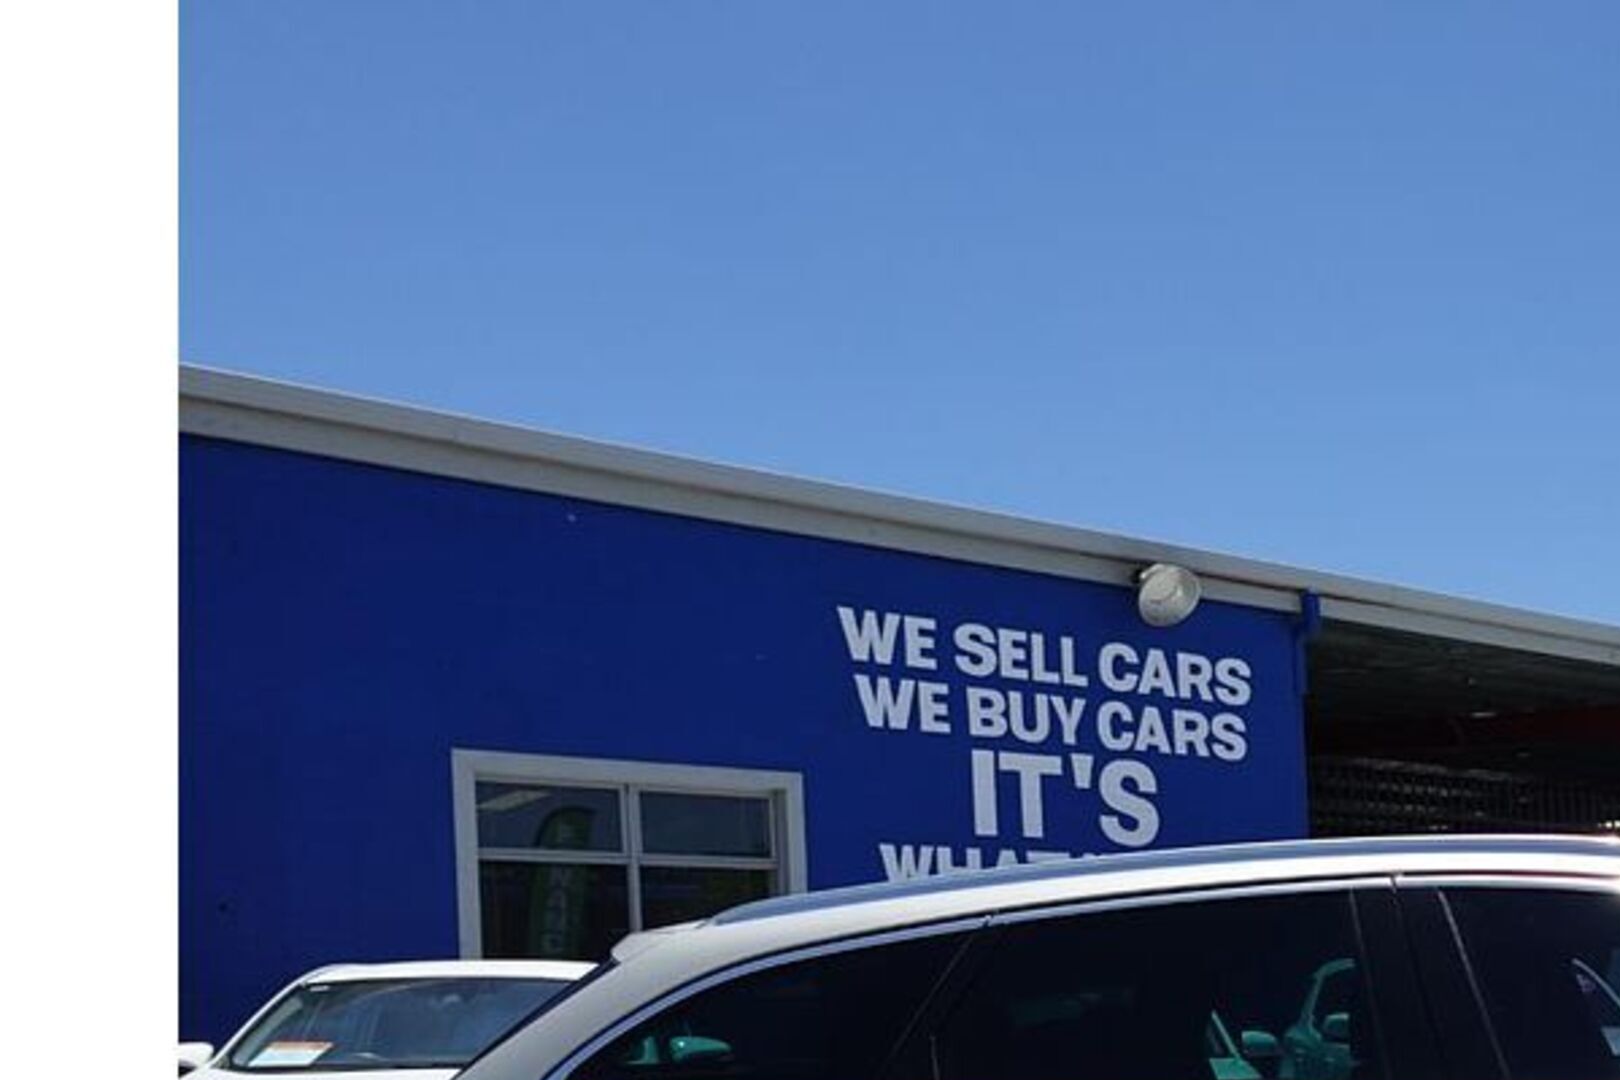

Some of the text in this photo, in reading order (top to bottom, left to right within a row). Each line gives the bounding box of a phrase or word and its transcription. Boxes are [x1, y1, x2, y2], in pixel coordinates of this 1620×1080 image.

[837, 606, 1252, 706] WE SELL CARS
[853, 674, 1247, 761] WE BUY CARS
[970, 749, 1160, 847] IT'S
